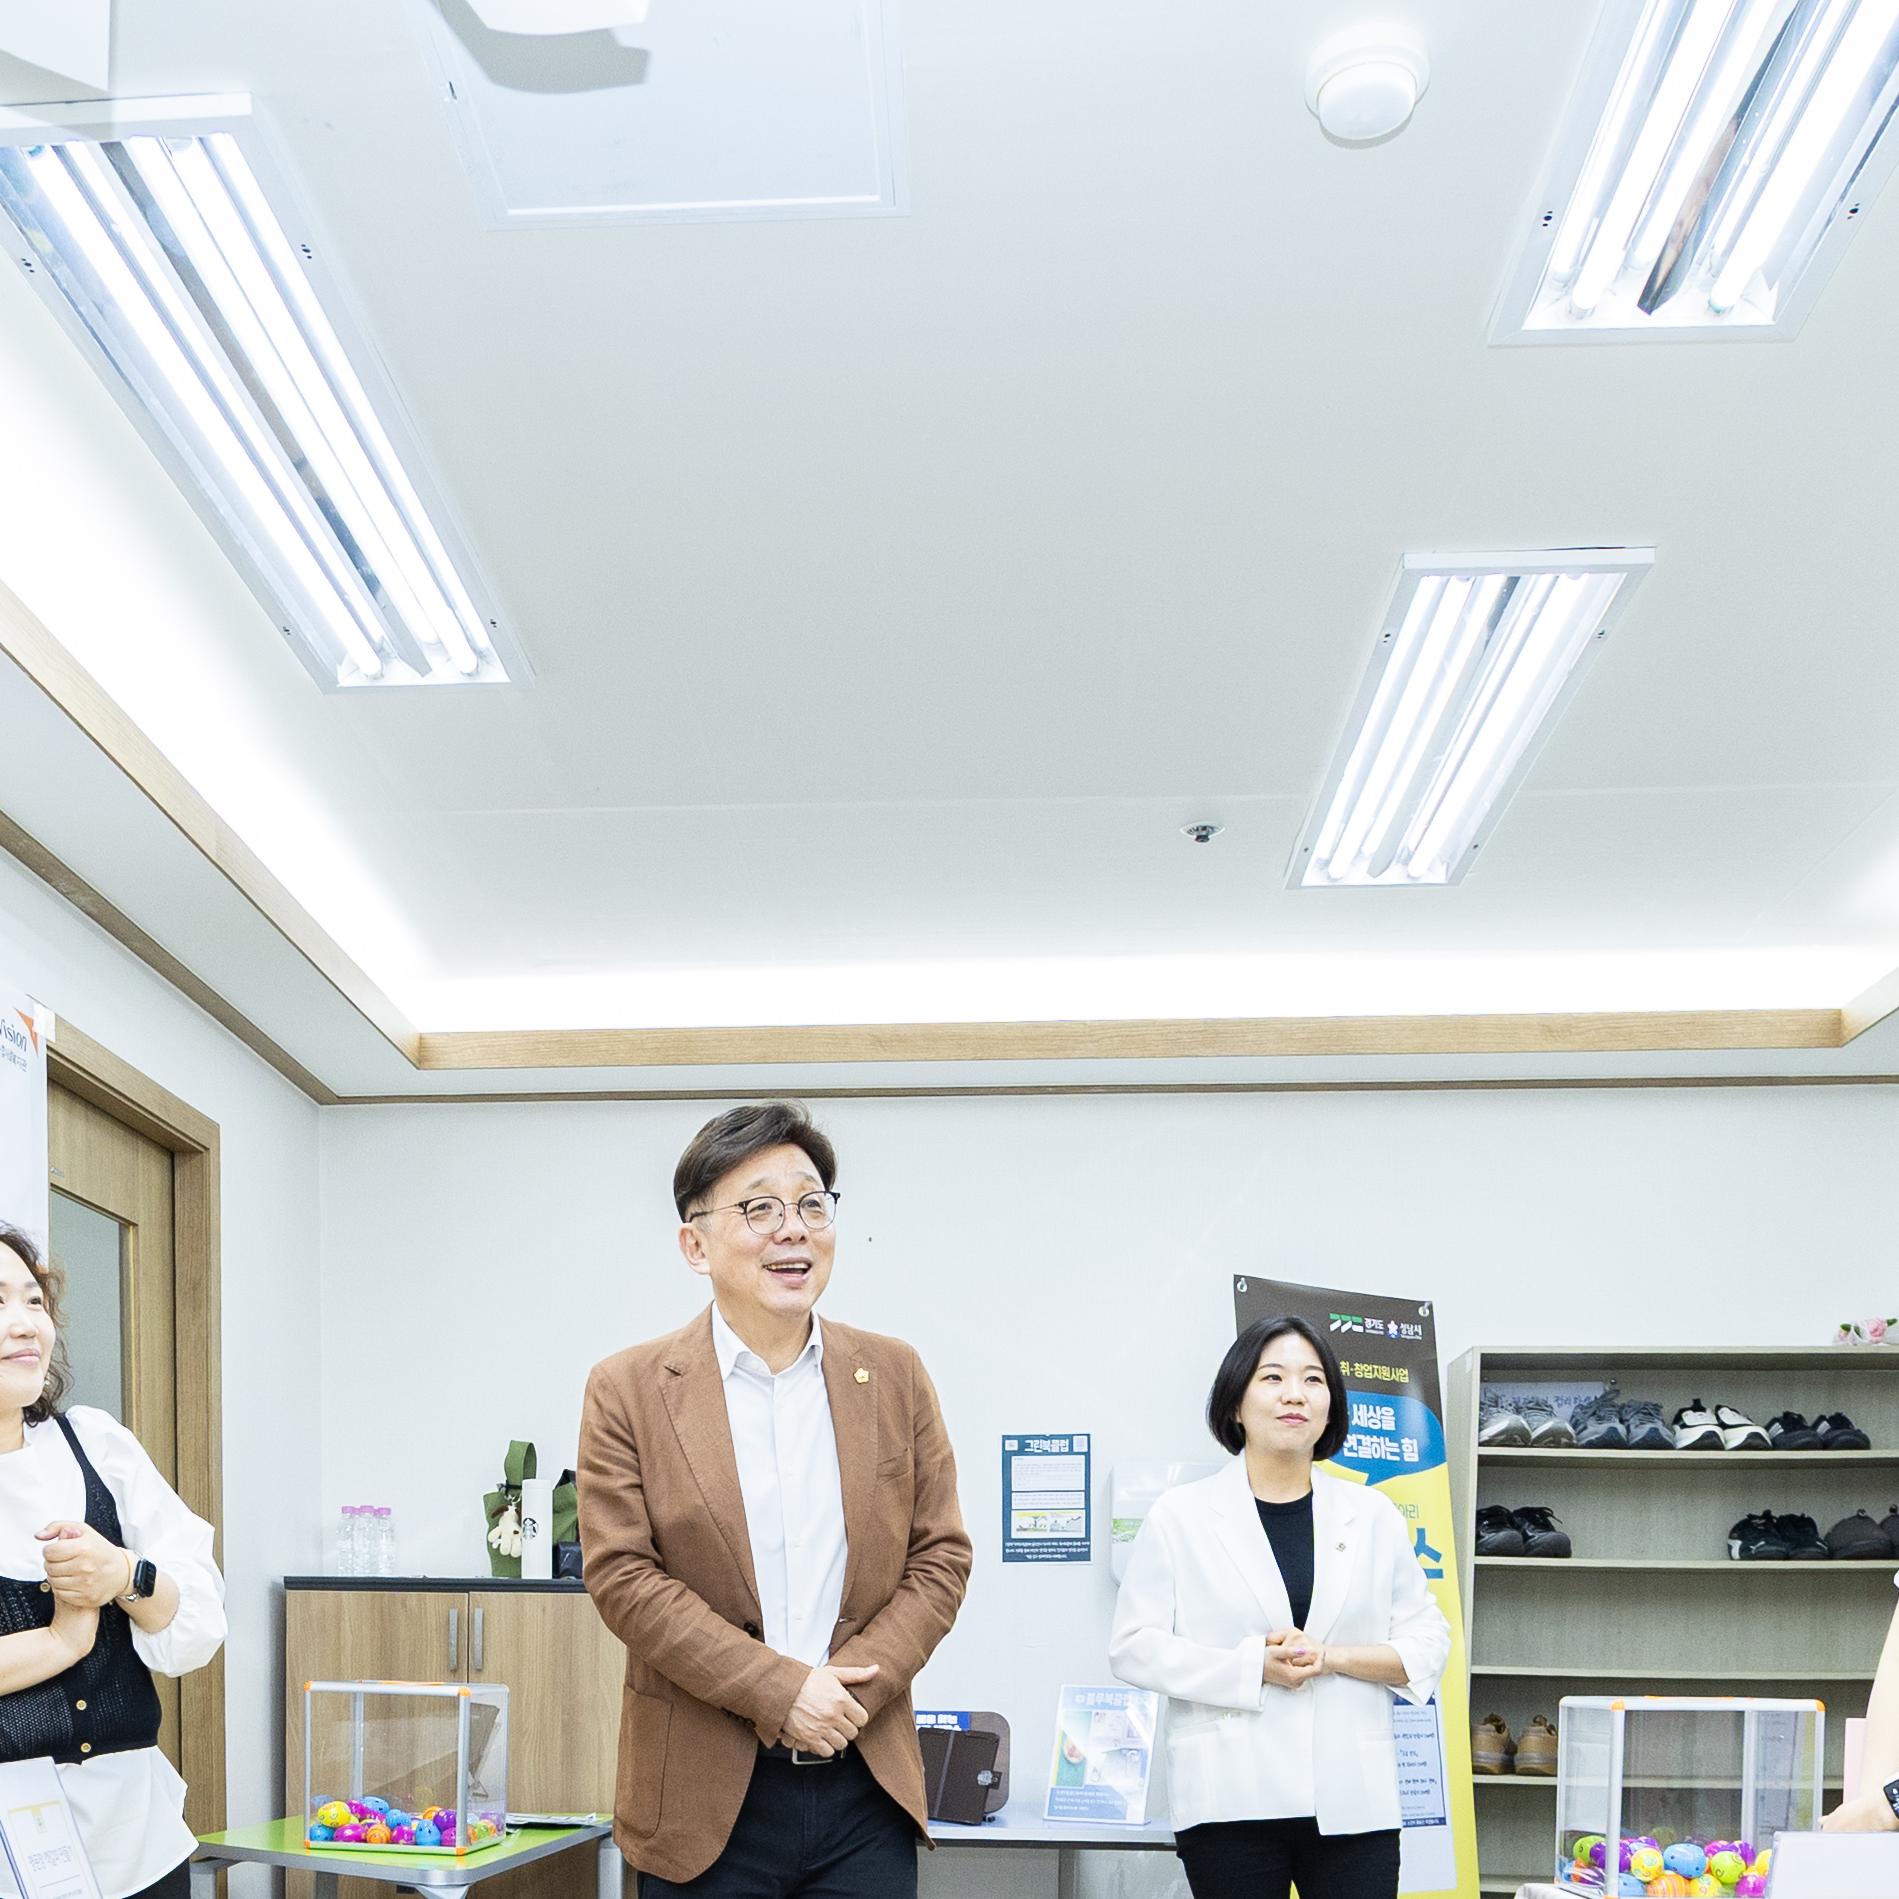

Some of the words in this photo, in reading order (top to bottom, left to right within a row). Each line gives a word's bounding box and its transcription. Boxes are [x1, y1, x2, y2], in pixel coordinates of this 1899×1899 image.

[1351, 1403, 1396, 1431] 세상을
[1342, 1433, 1401, 1462] 연결하는
[1401, 1436, 1420, 1463] 힘
[1398, 1504, 1419, 1519] 아리
